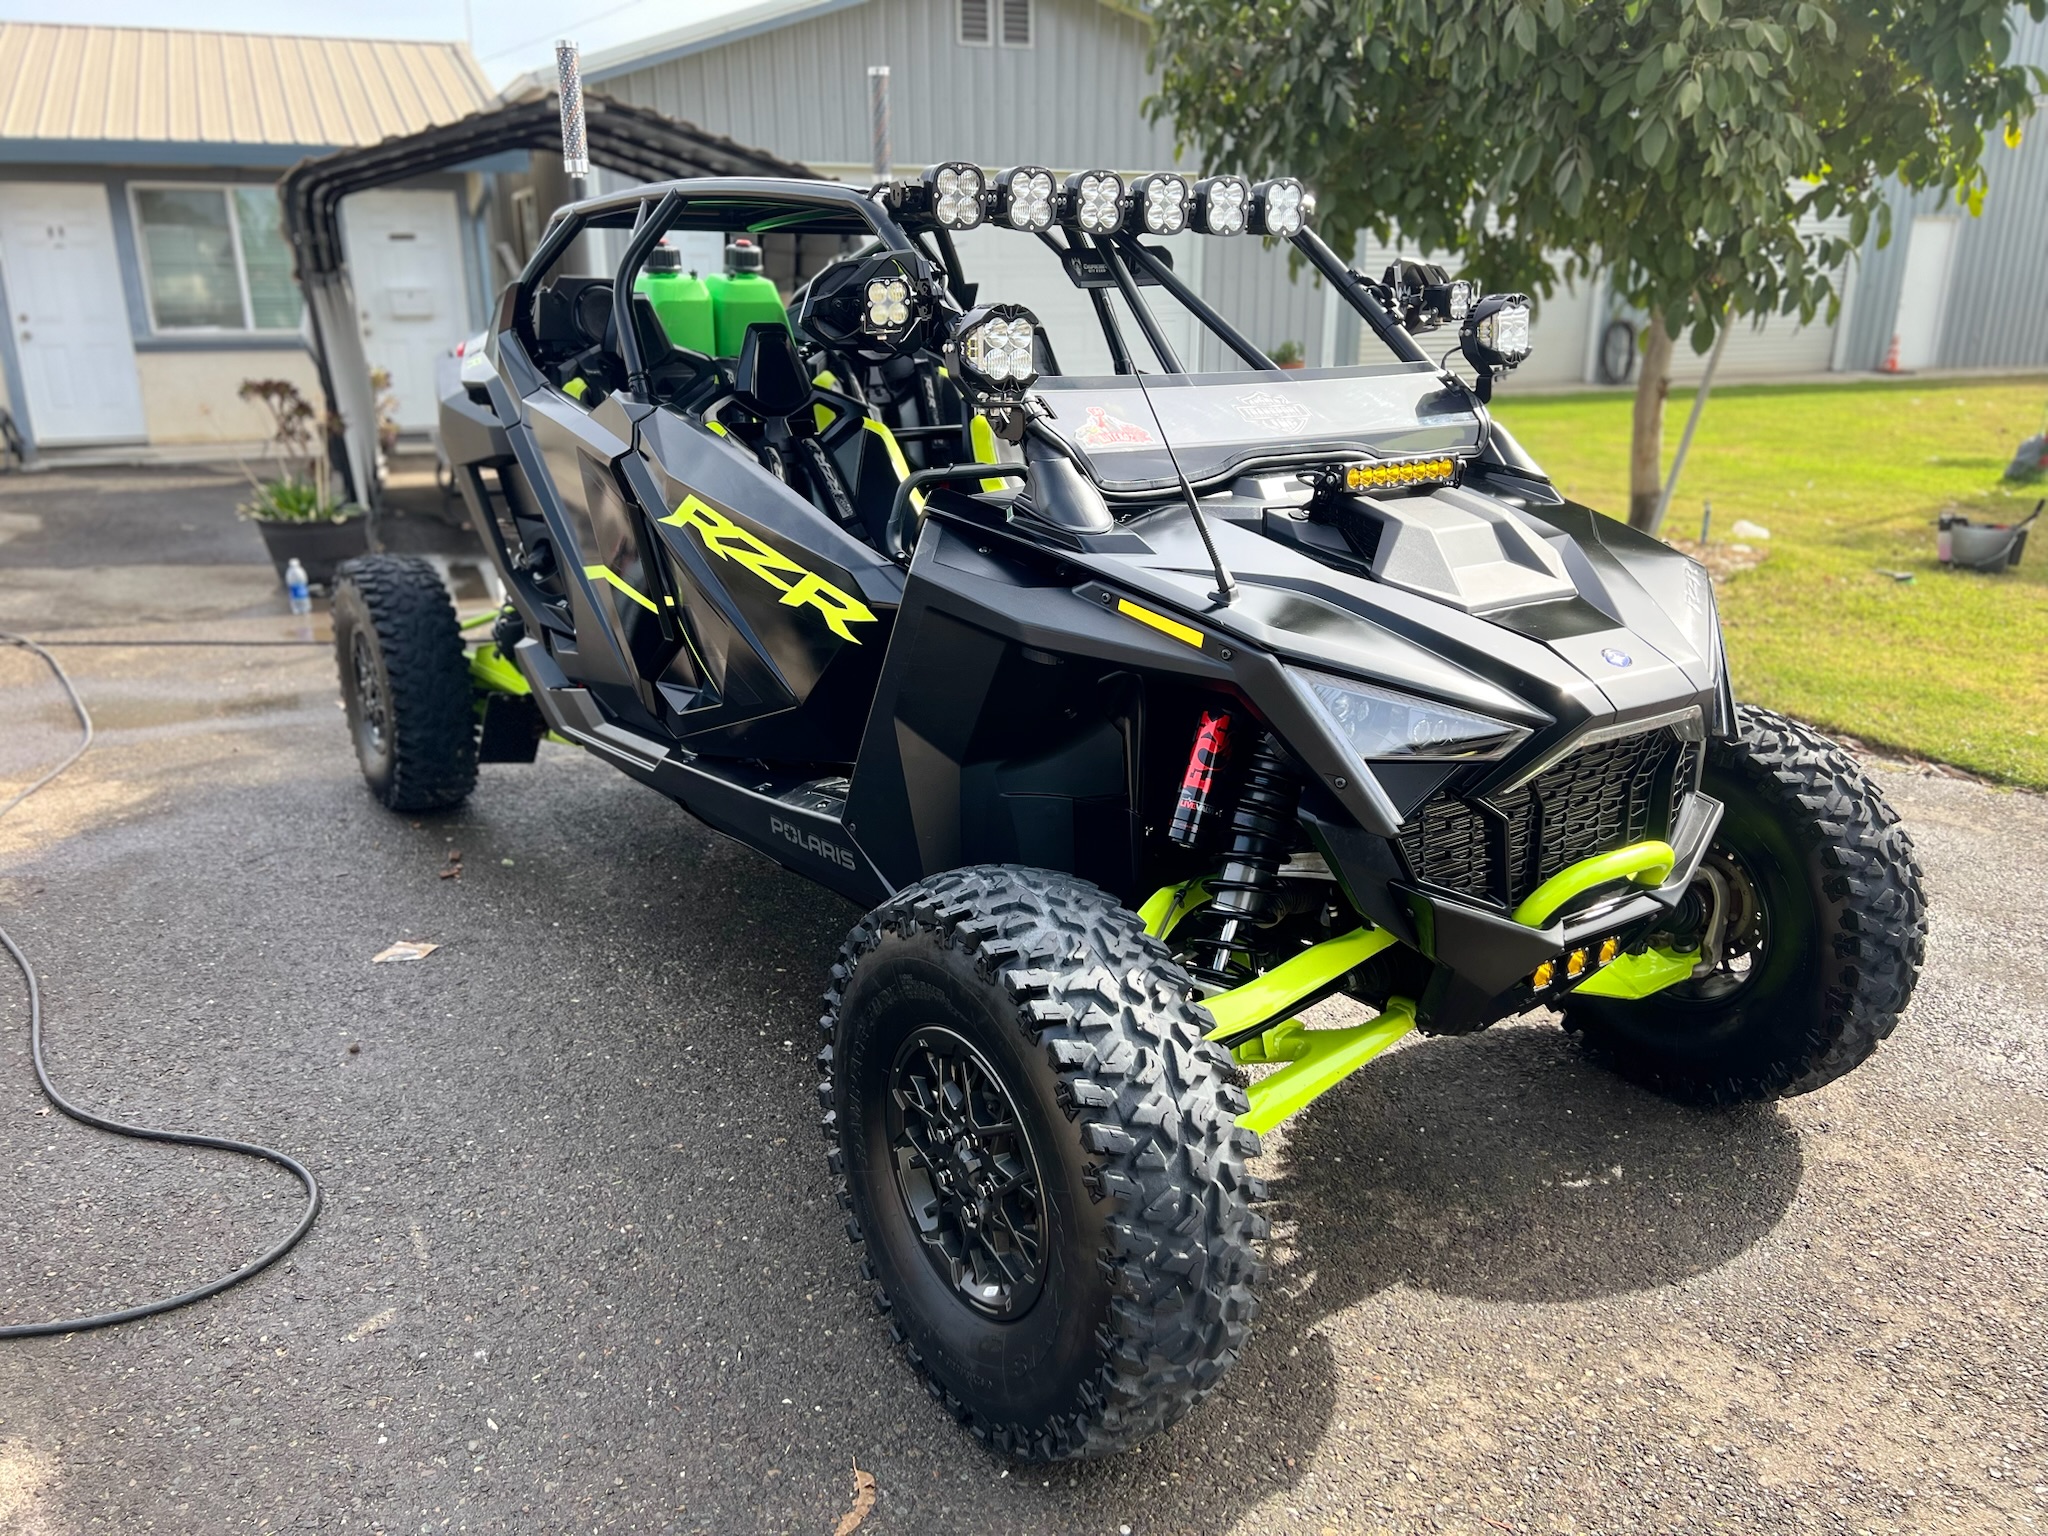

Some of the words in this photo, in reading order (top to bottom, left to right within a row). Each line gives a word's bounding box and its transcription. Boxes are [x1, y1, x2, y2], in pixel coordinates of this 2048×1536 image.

[657, 494, 878, 645] RZR
[1183, 710, 1231, 793] FOX
[770, 816, 856, 871] POLARIS
